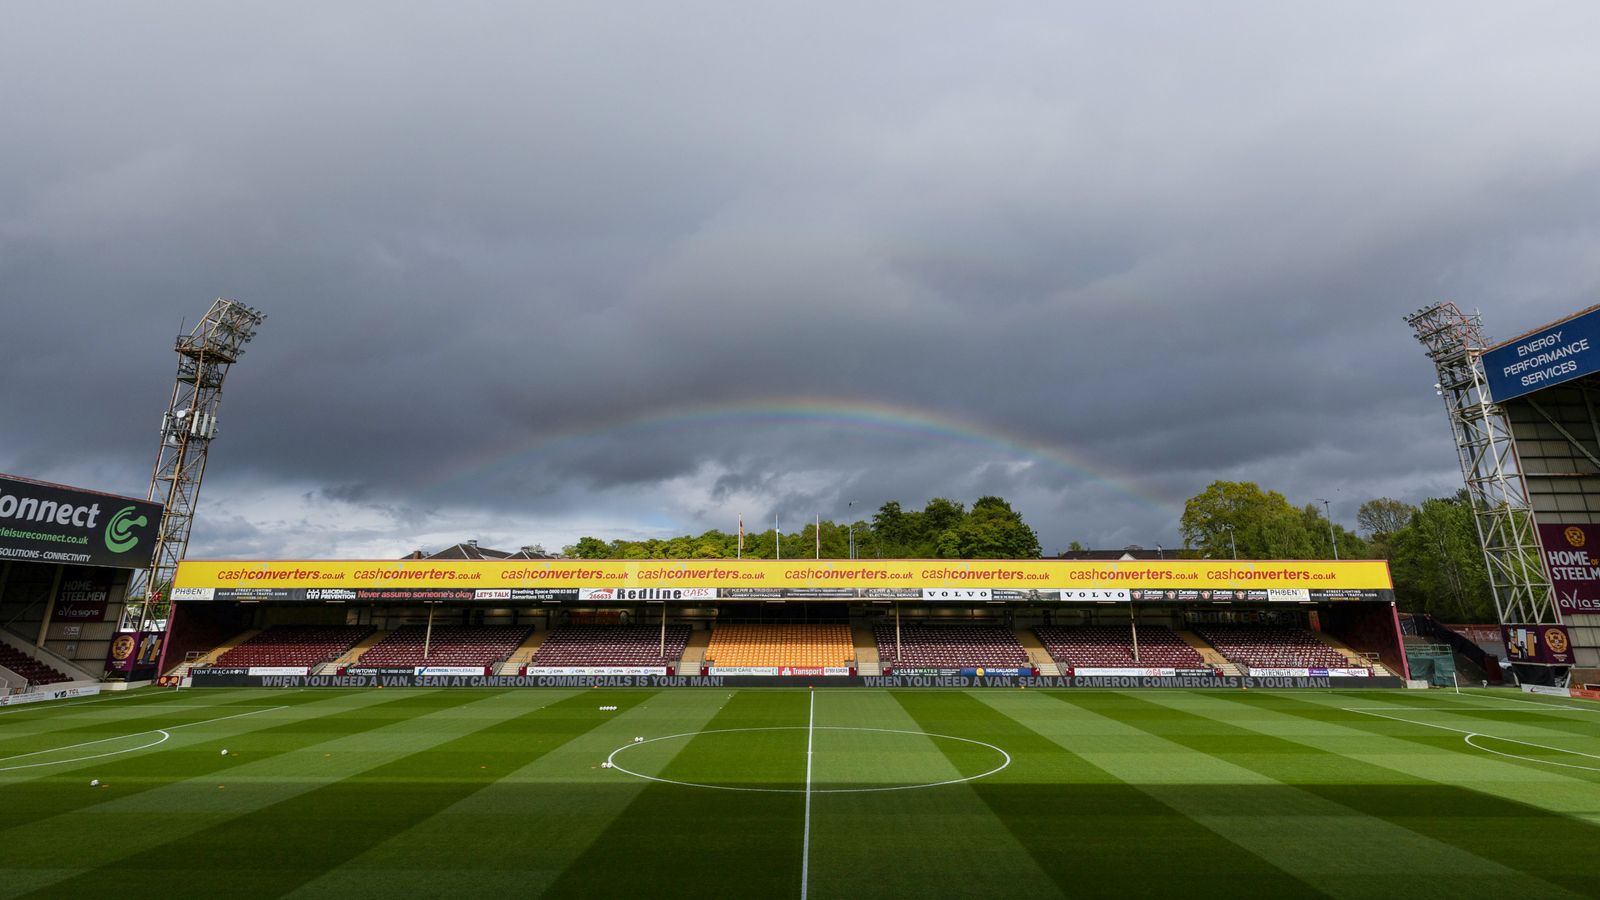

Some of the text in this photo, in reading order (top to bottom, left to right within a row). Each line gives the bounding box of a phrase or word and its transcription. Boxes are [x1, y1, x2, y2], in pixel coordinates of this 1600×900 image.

[1517, 331, 1562, 357] ENERGY
[1503, 338, 1590, 377] PERFORMANCE
[1521, 360, 1577, 387] SERVICES
[0, 494, 101, 528] onnect
[0, 527, 88, 544] leisureconnect.co.uk
[43, 551, 91, 562] CONNECTIVITY
[1548, 551, 1590, 566] HOME
[218, 568, 1336, 580] cashconverters.co.uk cashconverters.co.uk cashconverters.co.uk cashconverters.co.uk cashconverters.co.uk cashconverters.co.uk cashconverters.co.uk cashconverters.co.uk
[63, 581, 92, 590] HOME
[60, 592, 107, 601] STEELMEN
[455, 591, 474, 600] okay
[617, 588, 681, 599] Redline
[262, 676, 299, 686] WHEN
[303, 676, 329, 686] YOU
[332, 676, 366, 687] NEED
[369, 676, 378, 687] A
[415, 676, 448, 687] SEAN
[452, 676, 468, 687] AT
[470, 676, 534, 687] CAMERON
[538, 676, 632, 687] COMMERCIALS
[635, 676, 648, 686] IS
[652, 676, 686, 686] YOUR
[690, 676, 724, 686] MAN!
[863, 676, 902, 687] WHEN
[905, 676, 931, 687] YOU
[935, 676, 969, 687] NEED
[973, 676, 981, 687] A
[1018, 677, 1055, 687] SEAN
[1057, 677, 1072, 687] AT
[1075, 677, 1139, 687] CAMERON
[1142, 677, 1238, 688] COMMERCIALS
[1241, 677, 1254, 688] IS
[1257, 677, 1294, 688] YOUR
[1296, 677, 1331, 688] MAN!
